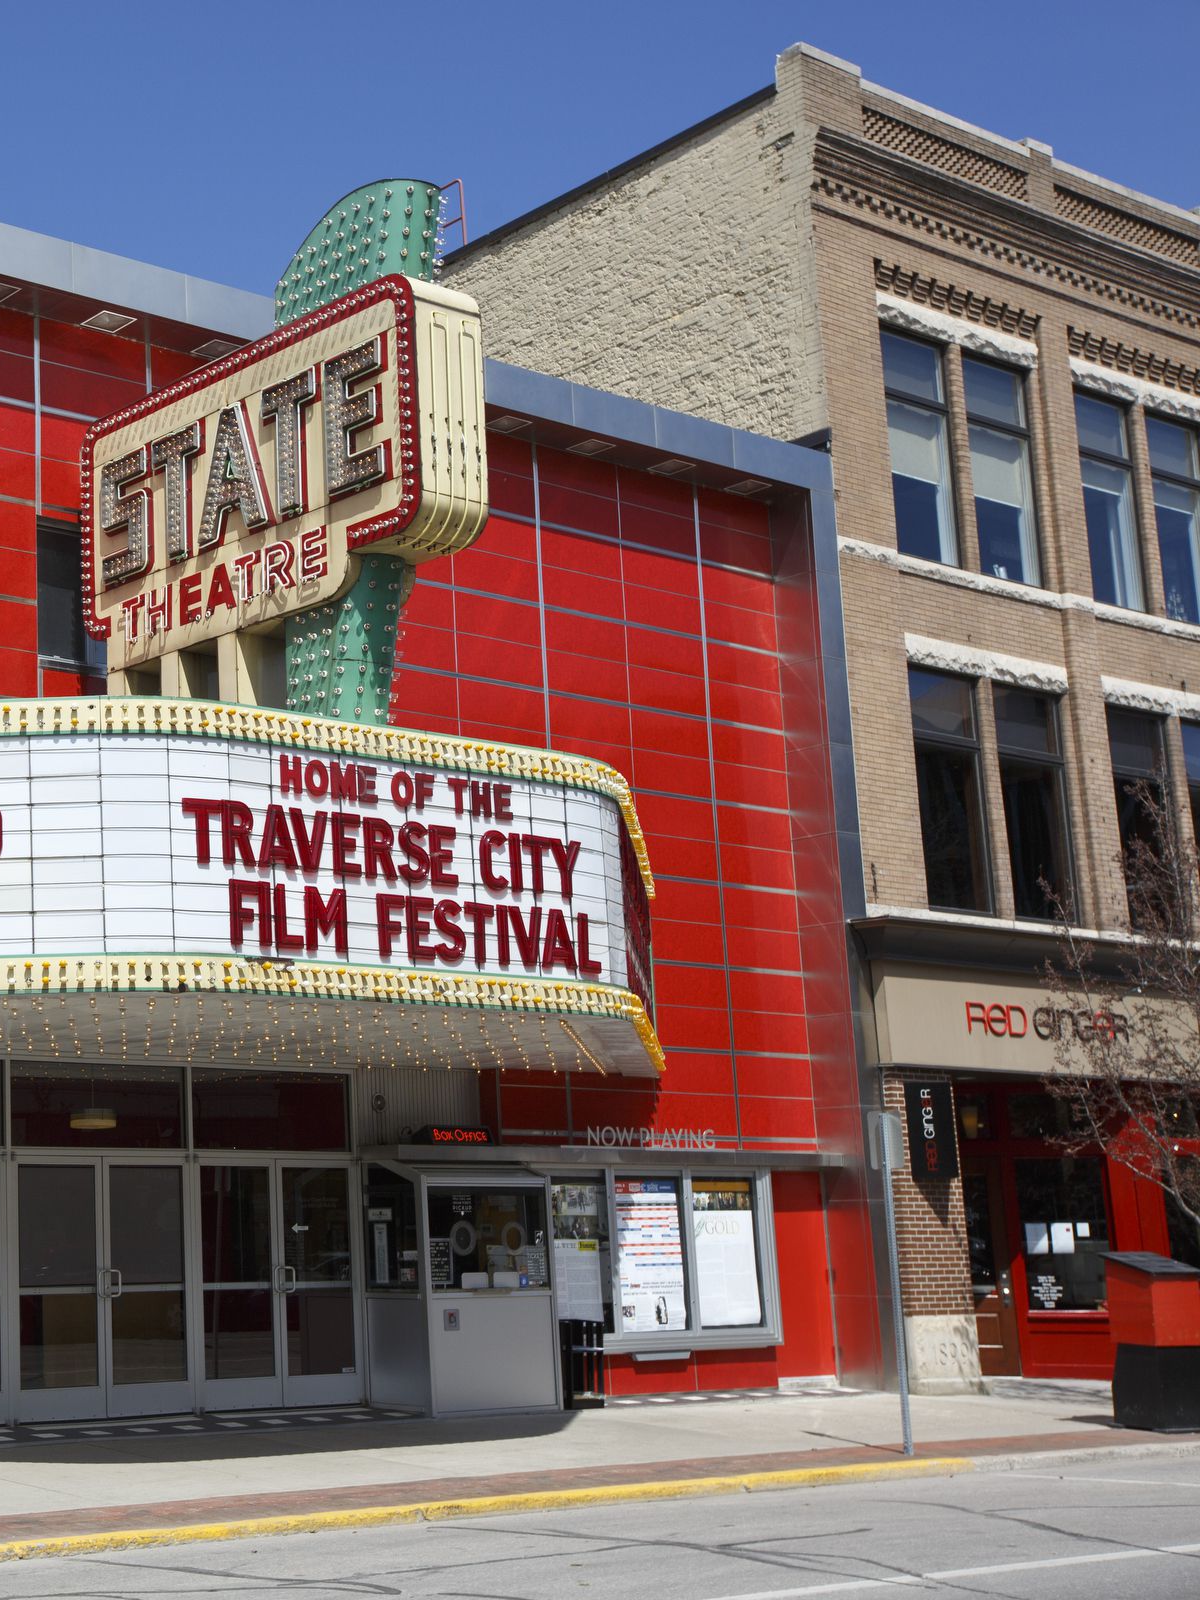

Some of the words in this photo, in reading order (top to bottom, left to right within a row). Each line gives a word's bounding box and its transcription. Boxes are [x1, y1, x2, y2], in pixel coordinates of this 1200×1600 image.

[101, 333, 392, 588] STATE
[121, 524, 329, 643] THEATRE
[279, 753, 379, 803] HOME
[390, 770, 435, 810] OF
[448, 777, 514, 821] THE
[181, 797, 460, 888] TRAVERSE
[479, 829, 582, 900] CITY
[229, 878, 349, 954] FILM
[375, 892, 603, 976] FESTIVAL
[586, 1126, 635, 1147] NOW
[639, 1128, 717, 1150] PLAYING
[705, 1219, 740, 1235] GOLD
